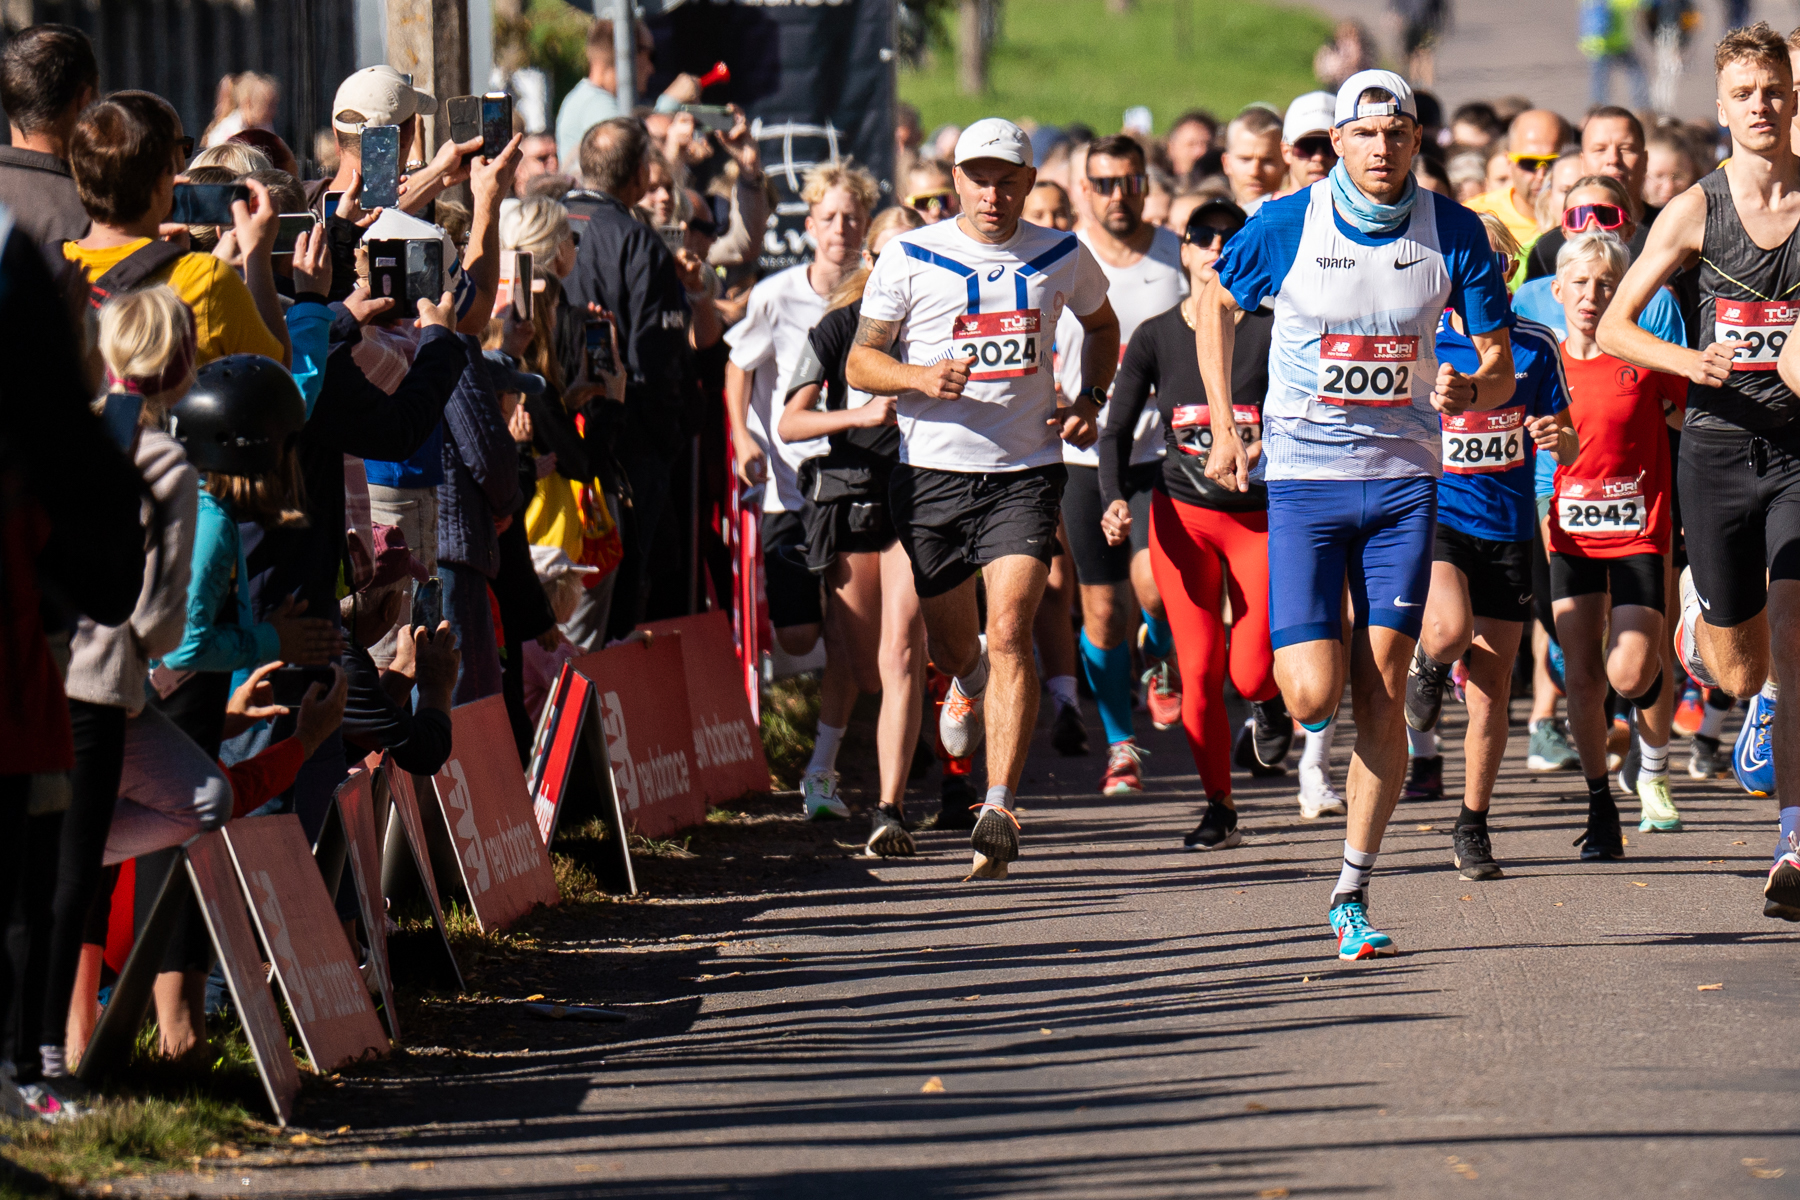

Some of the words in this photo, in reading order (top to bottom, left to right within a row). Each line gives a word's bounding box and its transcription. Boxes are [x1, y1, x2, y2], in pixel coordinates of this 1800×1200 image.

[1315, 256, 1356, 270] sparta
[1764, 306, 1800, 319] TÜR
[961, 337, 1037, 369] 3024
[1374, 341, 1413, 354] TÜRI
[1725, 330, 1792, 358] 299
[1323, 364, 1409, 395] 2002
[1180, 426, 1254, 448] 204
[1448, 433, 1519, 463] 2846
[1603, 481, 1638, 494] TÜRI
[1566, 502, 1640, 527] 2842
